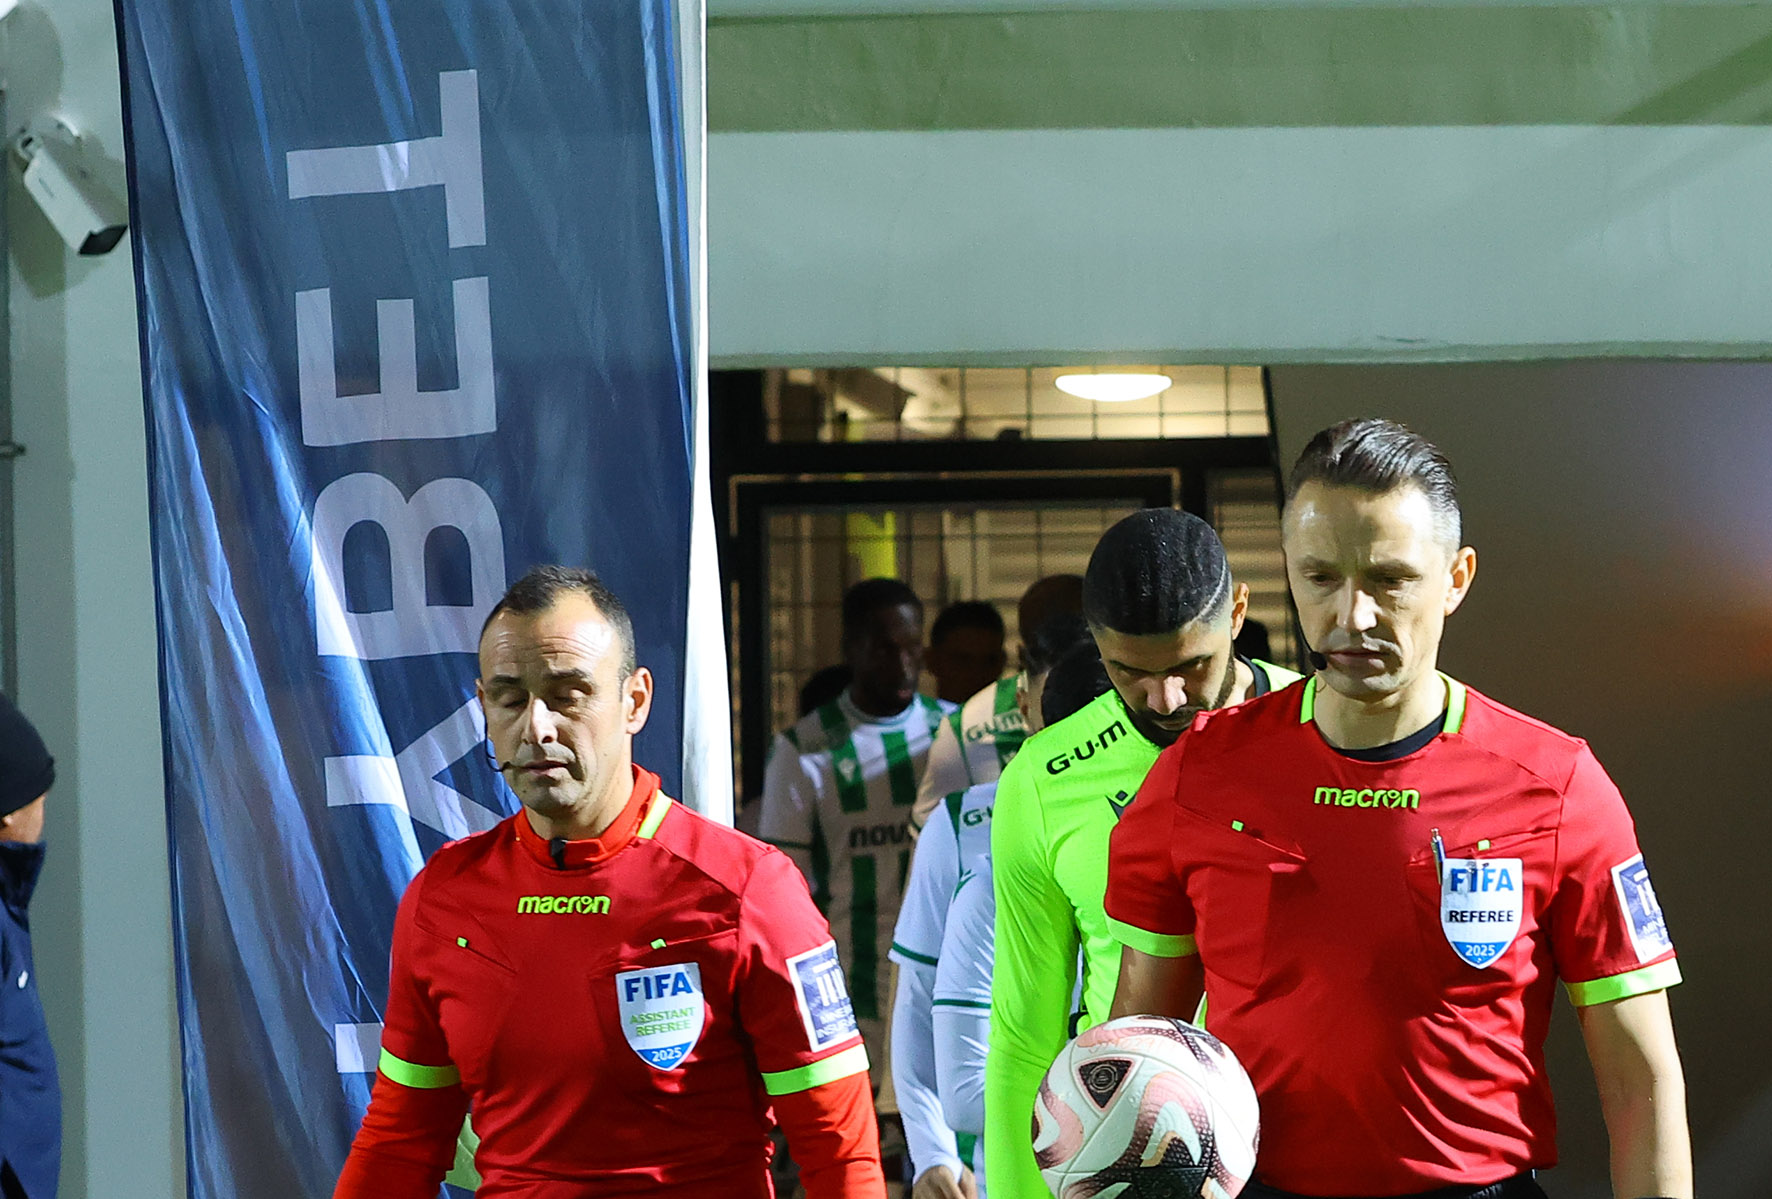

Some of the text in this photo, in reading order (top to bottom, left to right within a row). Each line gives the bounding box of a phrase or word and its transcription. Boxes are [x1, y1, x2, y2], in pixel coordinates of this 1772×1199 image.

[1314, 786, 1420, 809] macron
[1450, 868, 1514, 892] FIFA
[517, 895, 611, 915] macron
[1448, 910, 1514, 923] REFEREE
[1465, 945, 1496, 957] 2025
[624, 972, 693, 1003] FIFA
[629, 1006, 696, 1025] ASSISTANT
[635, 1019, 692, 1037] REFEREE
[651, 1047, 683, 1063] 2025
